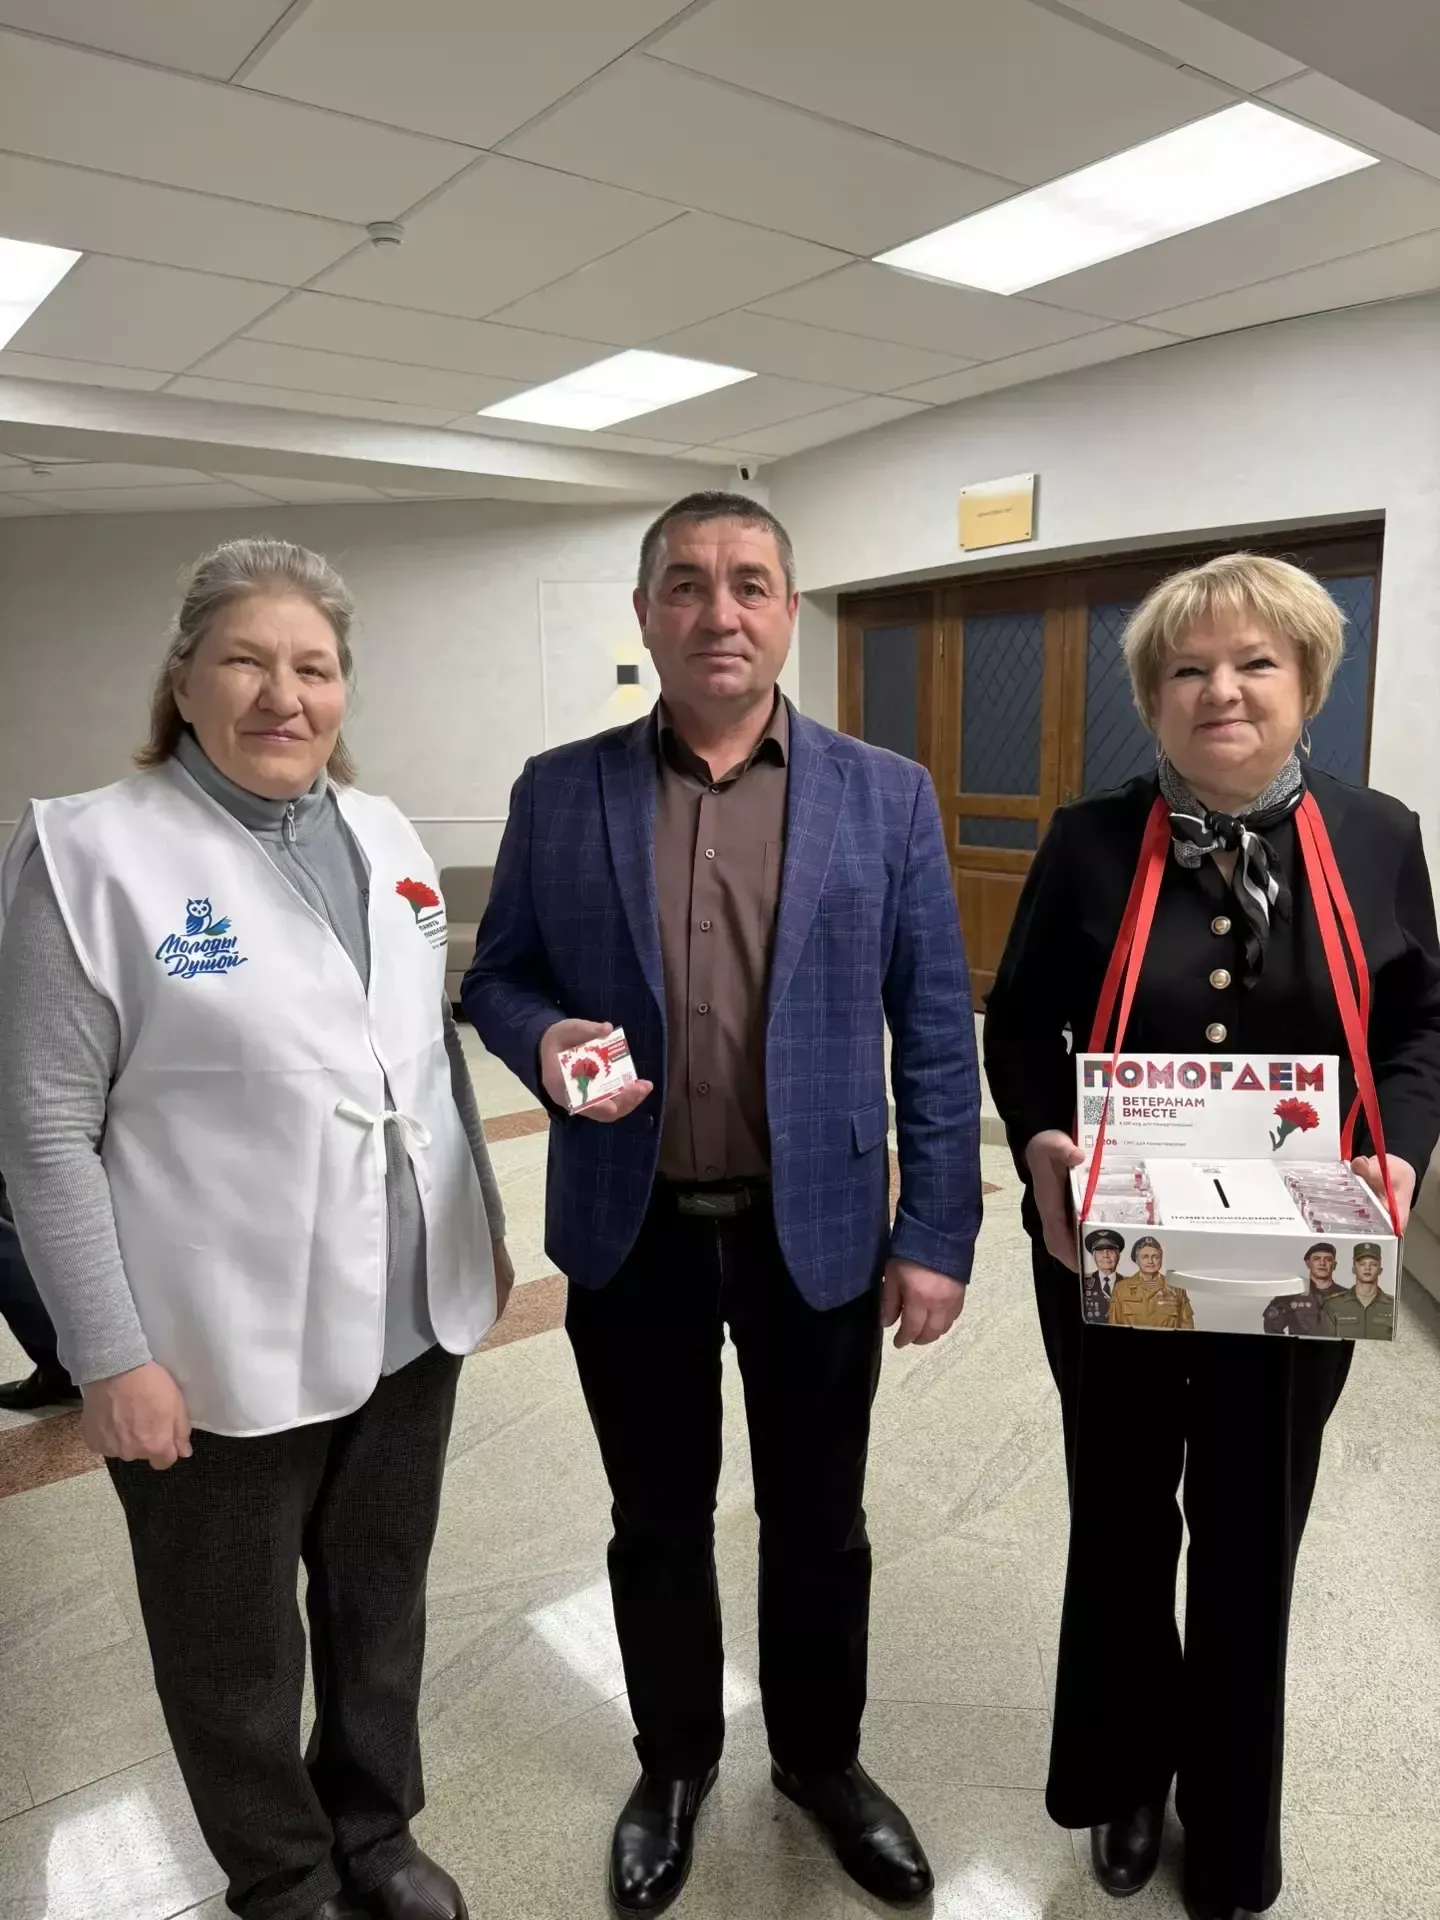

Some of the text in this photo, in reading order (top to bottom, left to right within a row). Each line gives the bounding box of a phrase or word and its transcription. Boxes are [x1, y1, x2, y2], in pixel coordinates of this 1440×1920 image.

[155, 934, 238, 960] Молоды
[164, 951, 248, 979] Душой
[1083, 1060, 1324, 1091] ПОМОГАЕМ
[1122, 1096, 1205, 1107] ВЕТЕРАНАМ
[1122, 1107, 1177, 1118] ВМЕСТЕ
